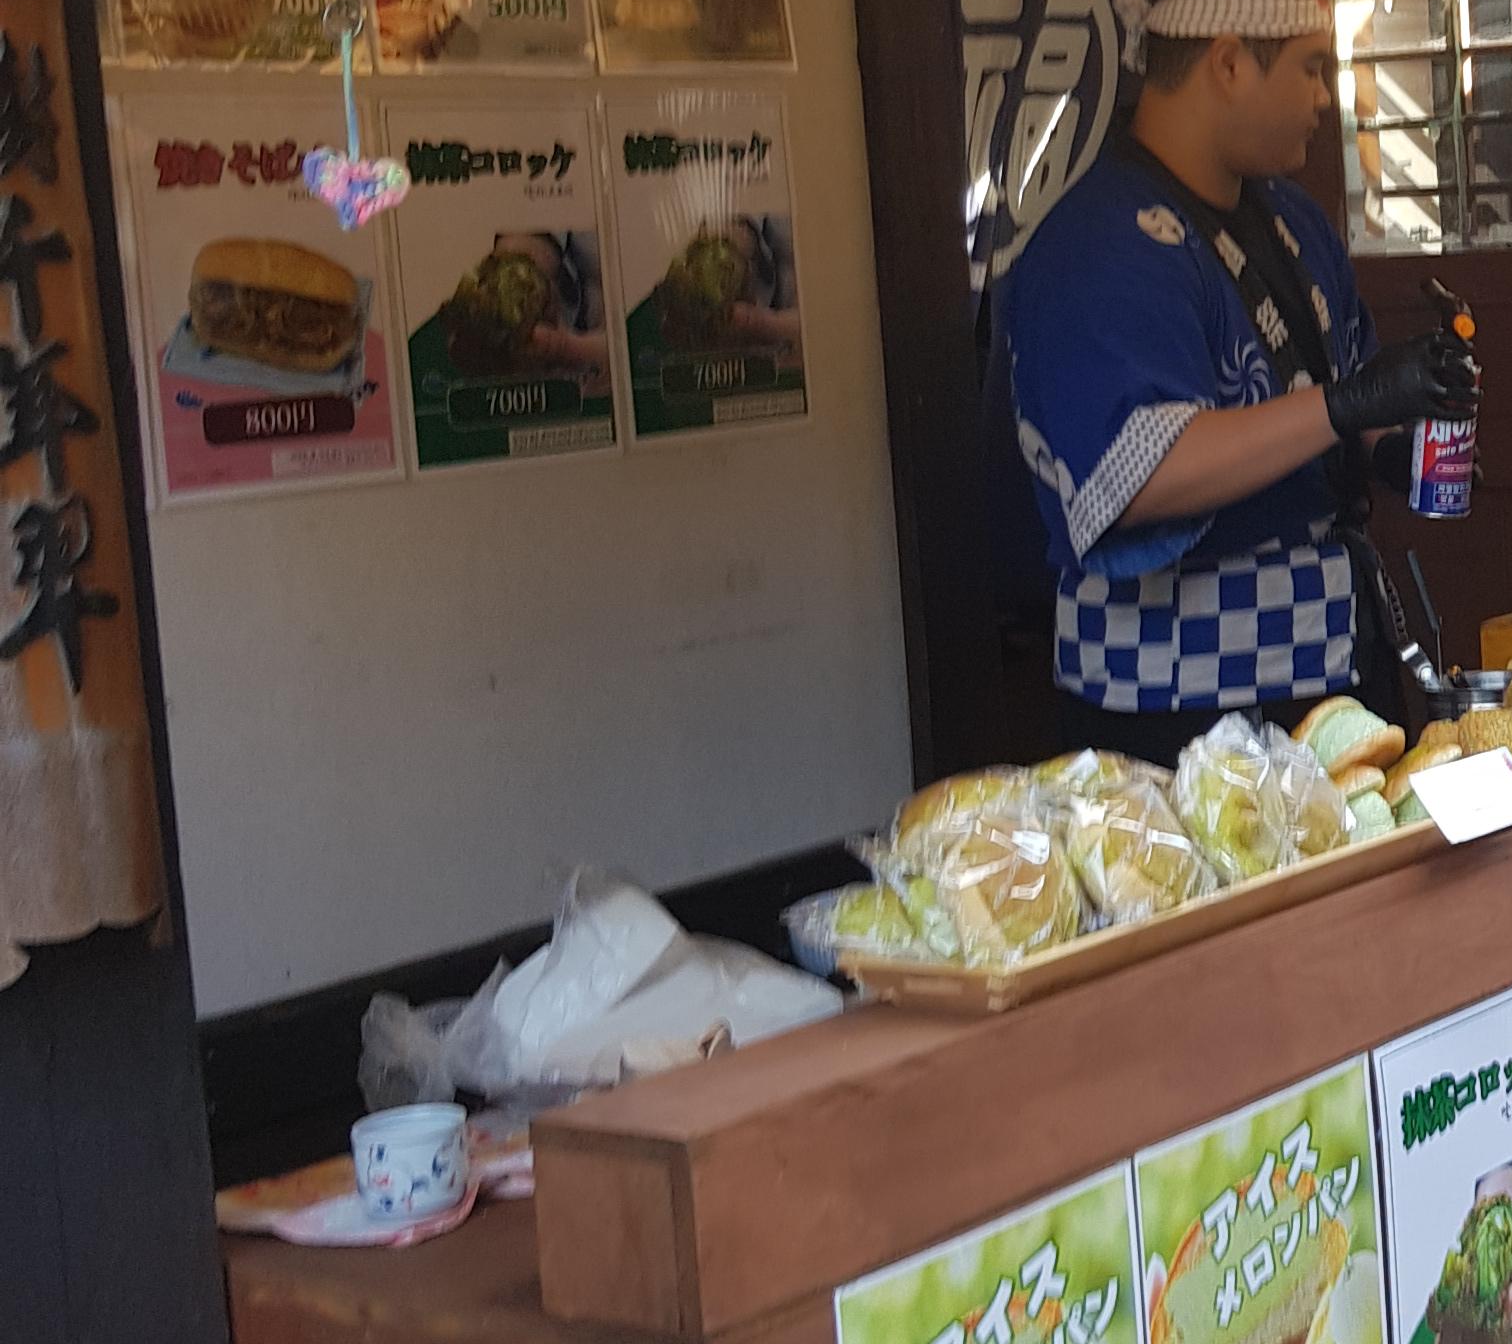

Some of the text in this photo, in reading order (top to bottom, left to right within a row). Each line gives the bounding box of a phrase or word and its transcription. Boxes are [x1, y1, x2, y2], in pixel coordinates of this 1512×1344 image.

[695, 358, 746, 391] 700円
[485, 380, 549, 417] 700円
[246, 404, 317, 436] 800円
[1201, 1120, 1320, 1262] アイス
[1212, 1156, 1361, 1329] メロンパン
